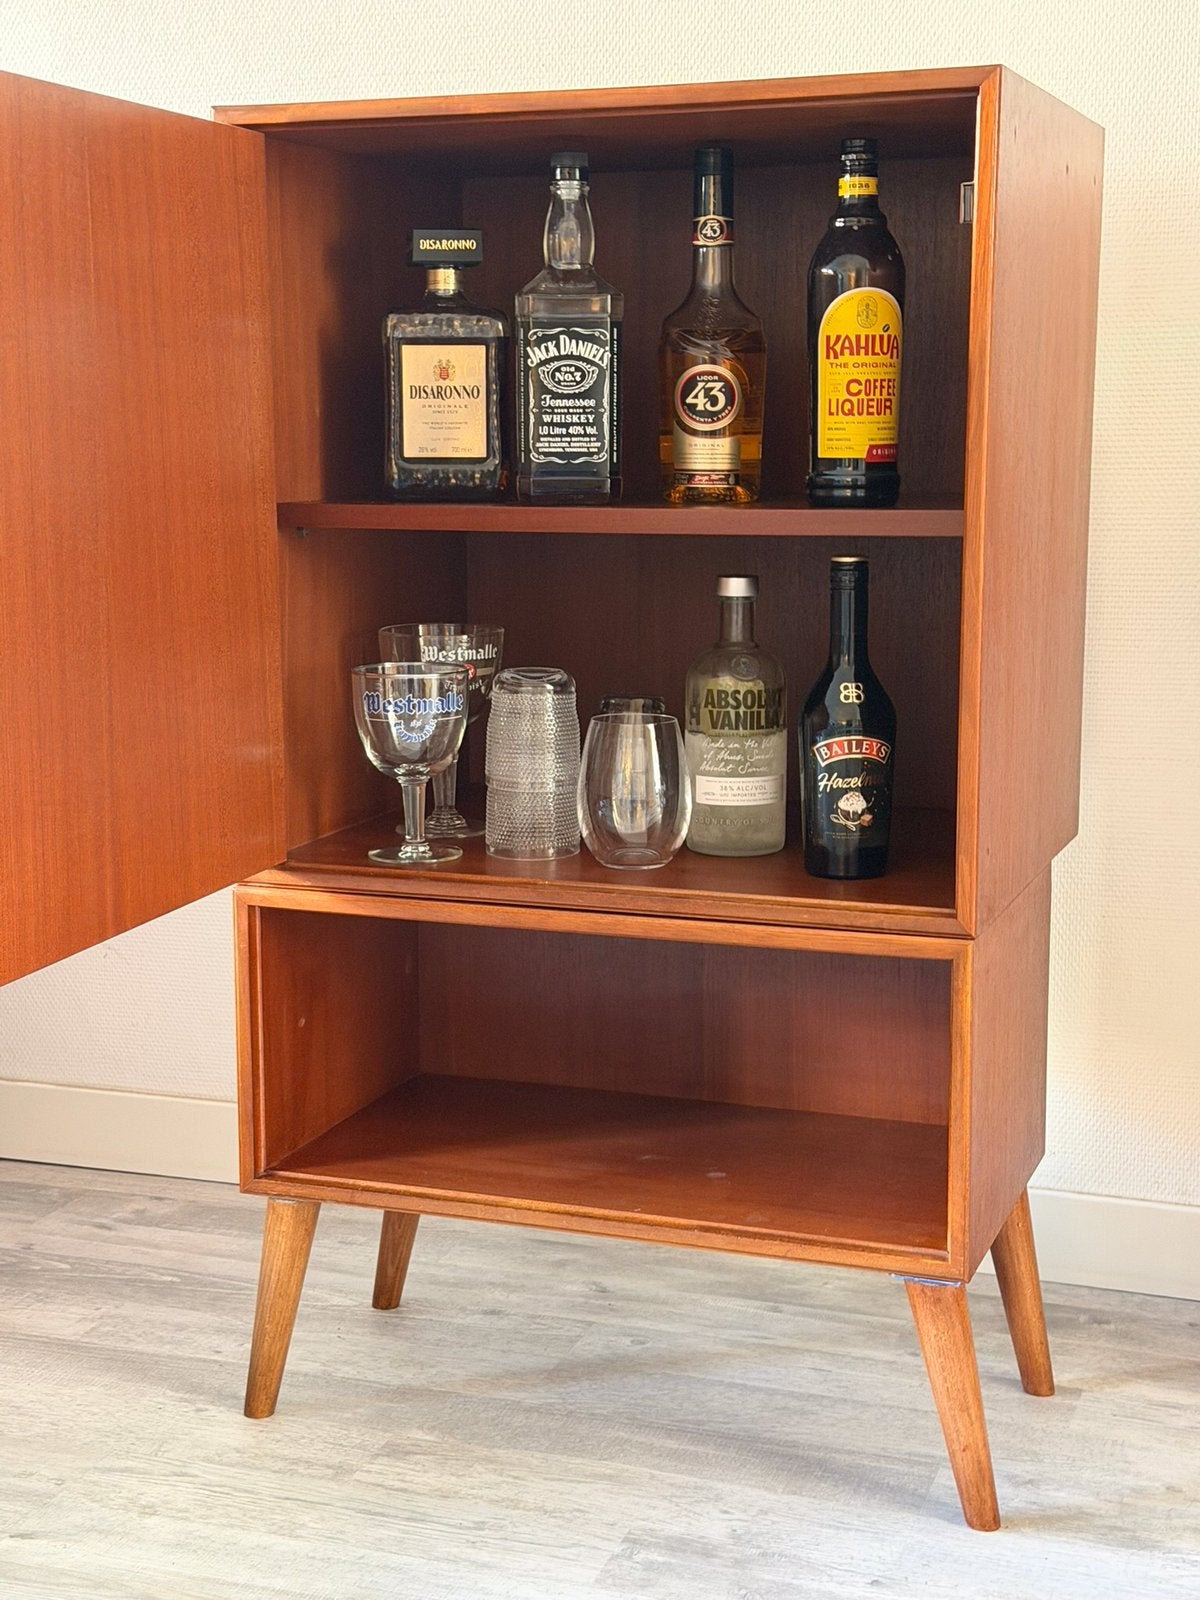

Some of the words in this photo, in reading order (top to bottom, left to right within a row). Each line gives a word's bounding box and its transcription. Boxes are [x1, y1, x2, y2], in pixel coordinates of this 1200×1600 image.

[701, 222, 721, 237] 43
[419, 239, 477, 250] DISARONNO
[526, 340, 559, 367] JACK
[559, 335, 611, 369] DANIEL'S
[409, 385, 480, 401] DISARONNO
[685, 381, 726, 411] 43
[845, 378, 896, 397] COFFEE
[541, 394, 596, 407] Tennessee
[828, 398, 893, 416] LIQUEUR
[541, 414, 596, 423] WHISKEY
[550, 426, 567, 435] Litre
[568, 426, 585, 435] 40%
[422, 643, 498, 662] Westmalle
[363, 691, 463, 715] Westmalle
[704, 688, 779, 709] ABSOL
[708, 709, 779, 731] VANIL
[819, 740, 889, 760] BAILEYS
